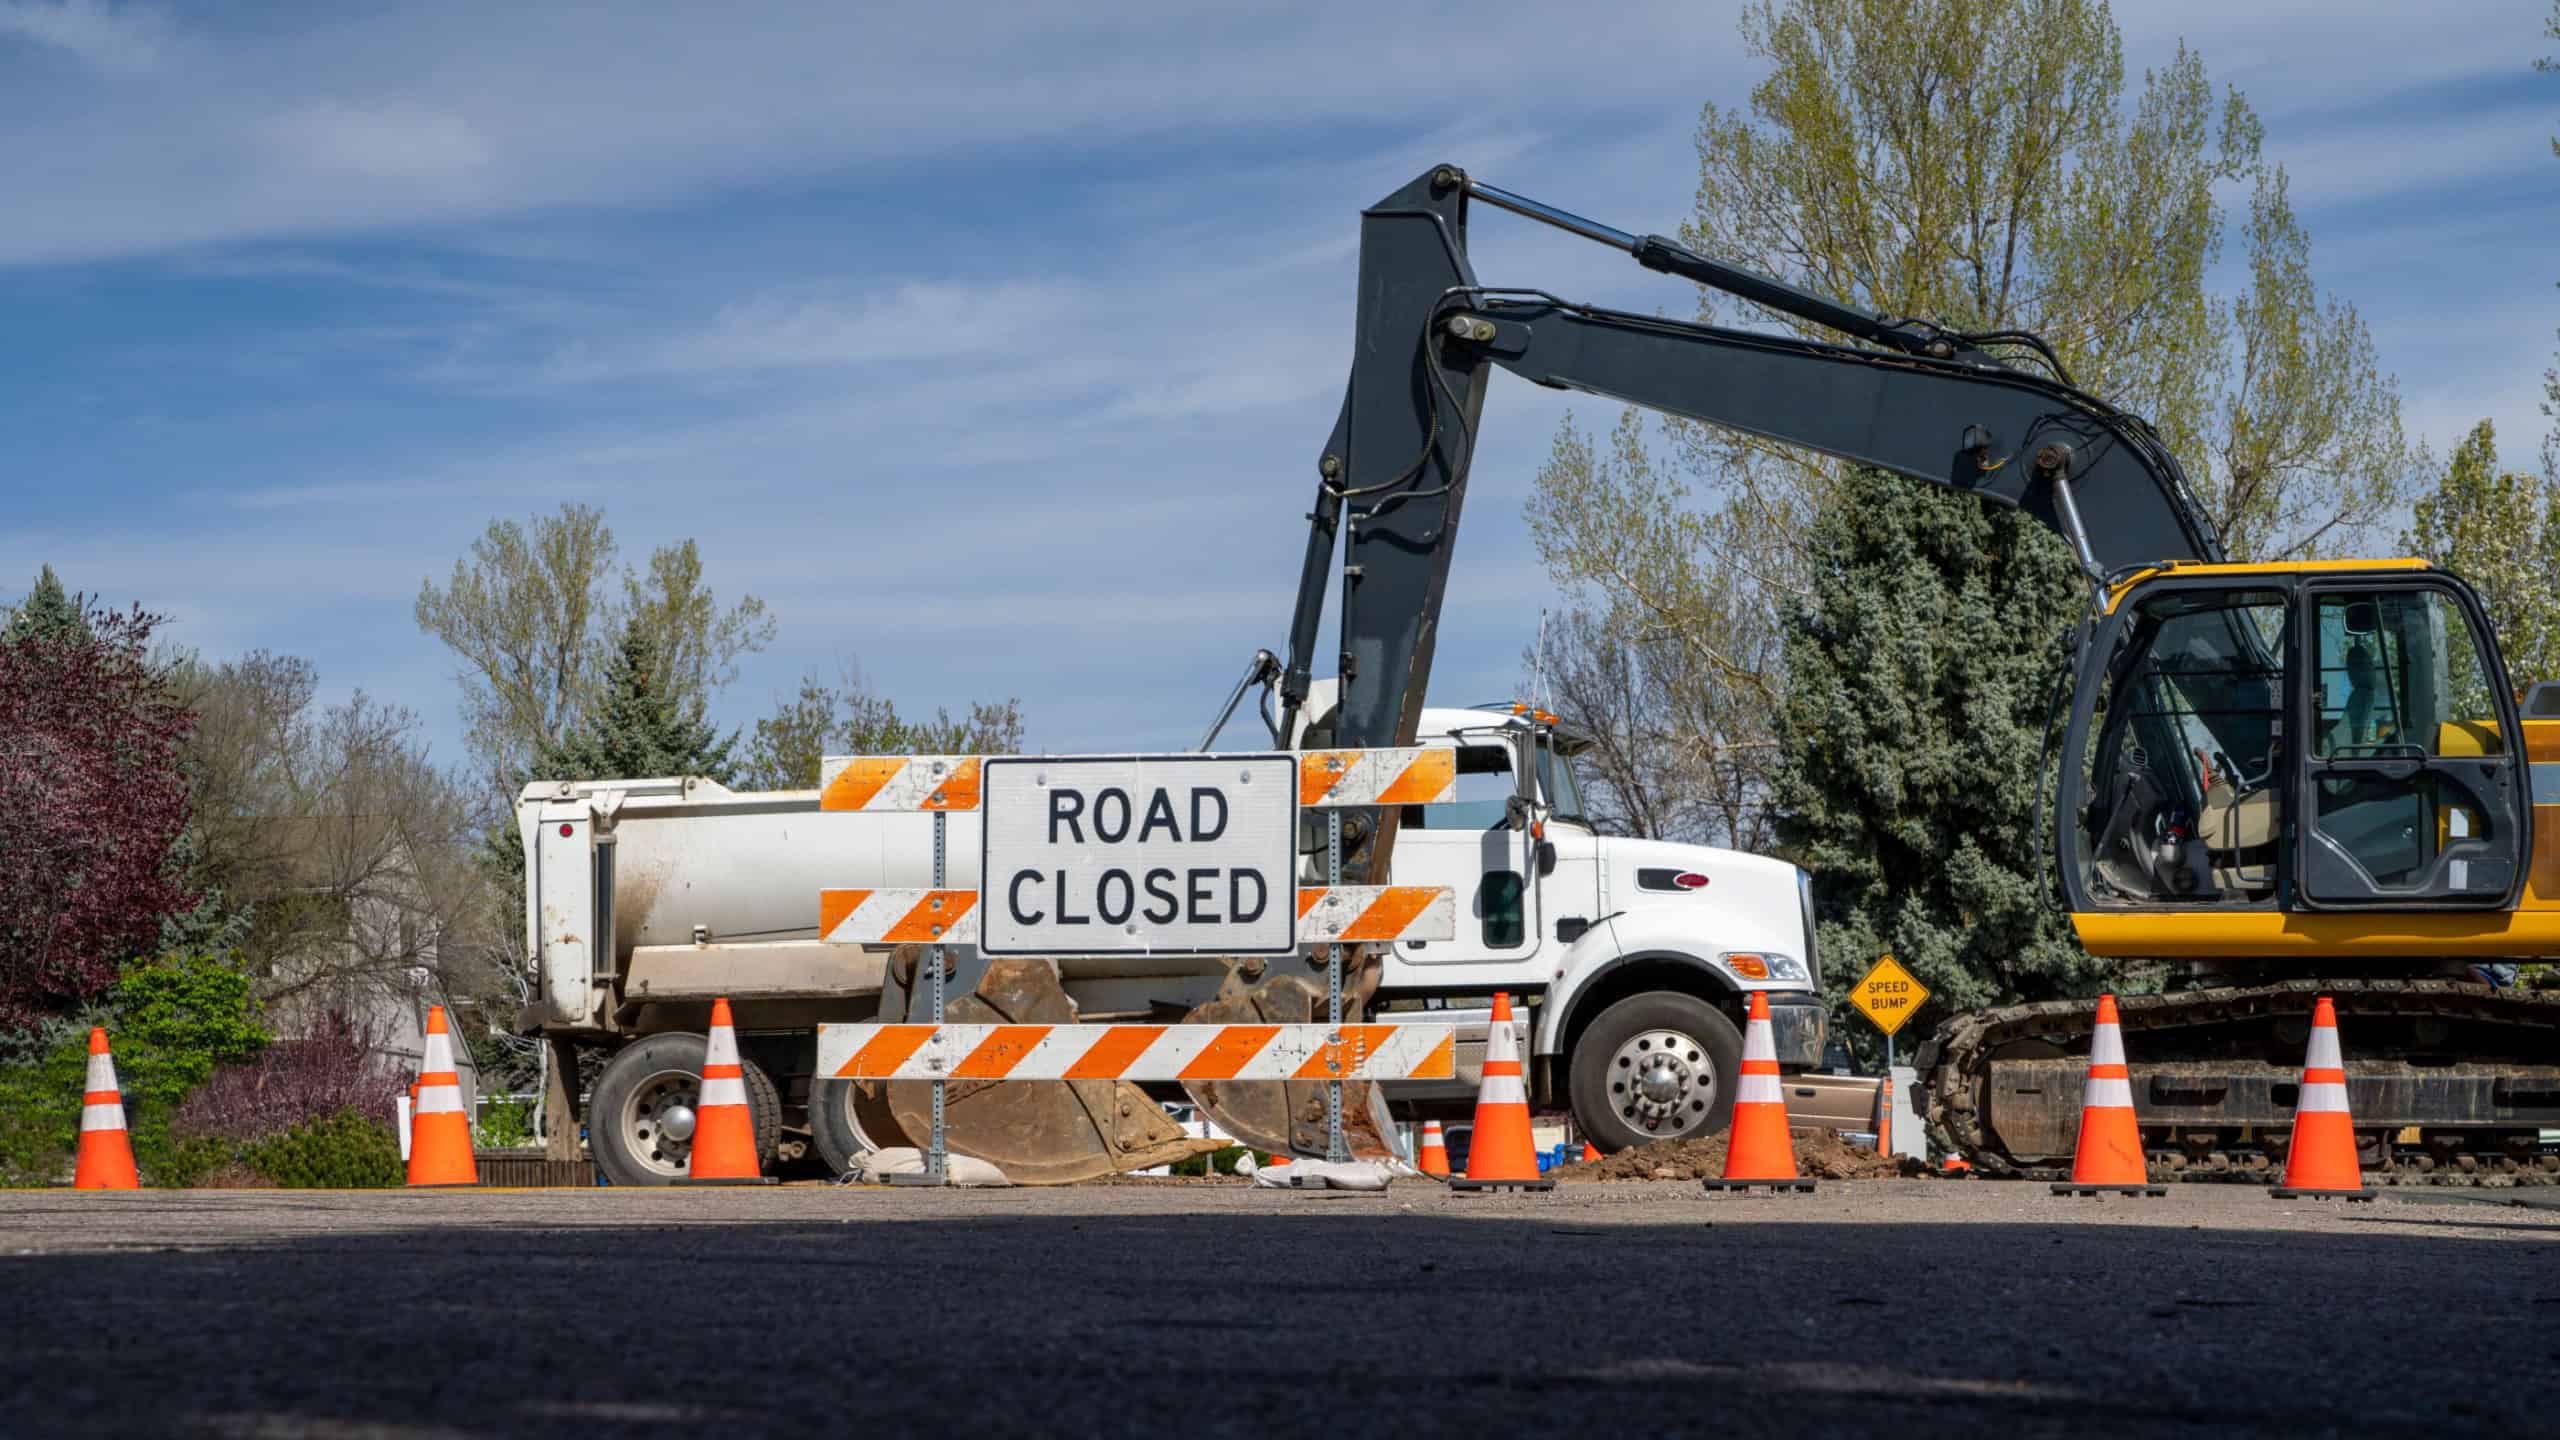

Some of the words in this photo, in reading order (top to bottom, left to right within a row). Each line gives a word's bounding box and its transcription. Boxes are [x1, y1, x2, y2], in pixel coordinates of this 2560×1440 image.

[1048, 787, 1228, 844] ROAD
[1008, 868, 1268, 926] CLOSED
[1868, 981, 1909, 994] SPEED
[1871, 997, 1908, 1010] BUMP
